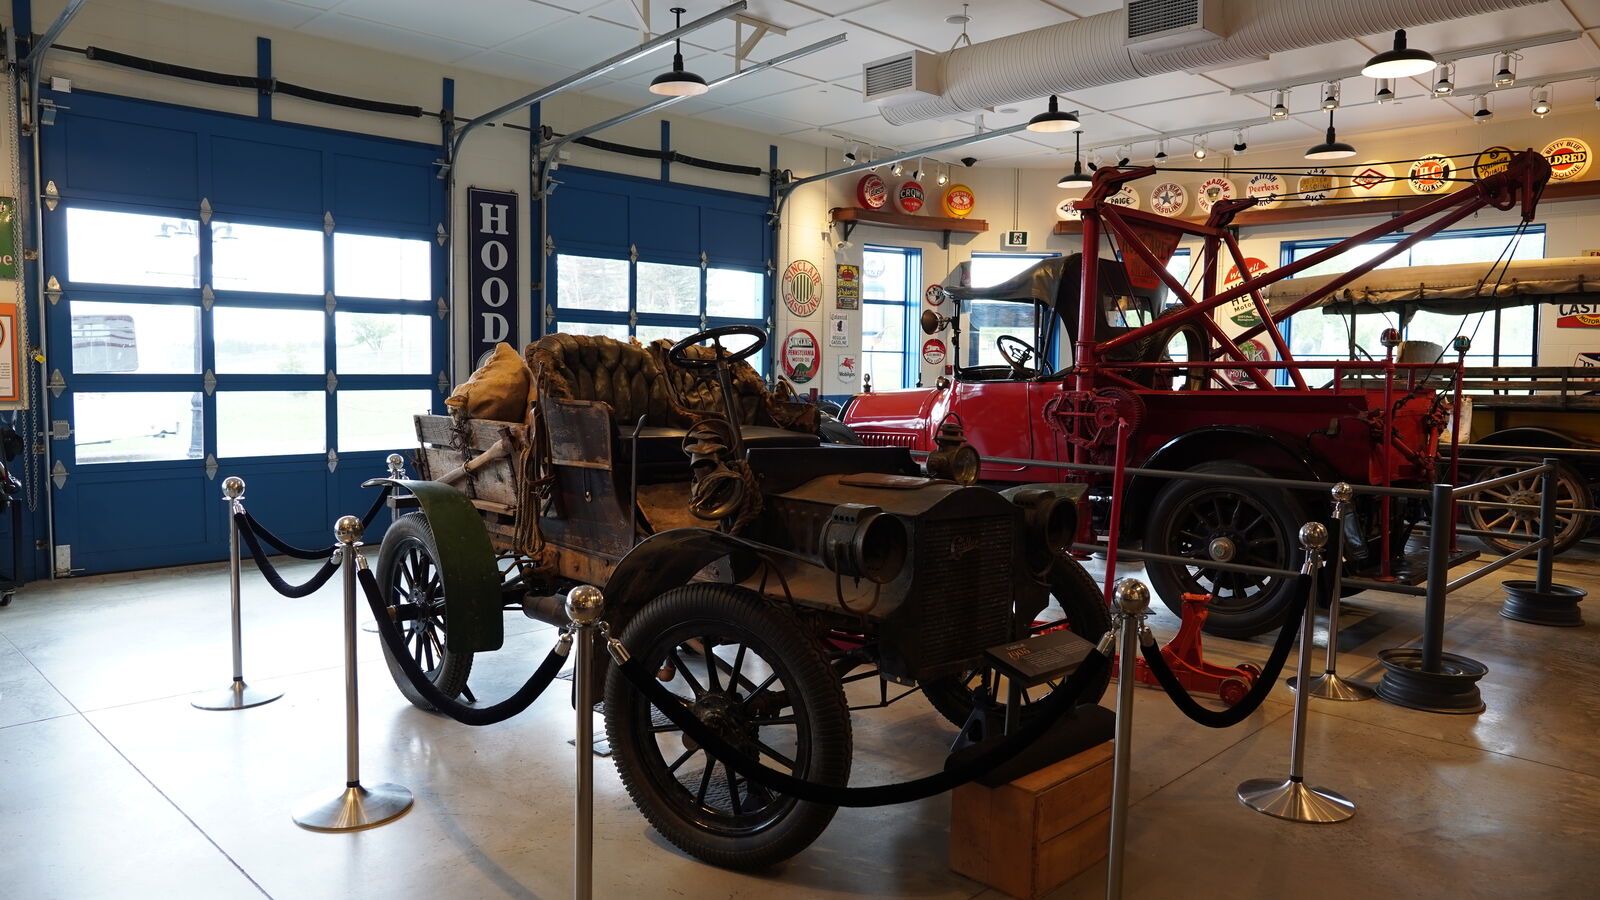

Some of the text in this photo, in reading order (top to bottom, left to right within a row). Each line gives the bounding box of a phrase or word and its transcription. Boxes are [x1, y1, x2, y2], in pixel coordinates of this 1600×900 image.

[1545, 141, 1582, 154] BETTY BLUE
[1545, 152, 1586, 165] LDRED
[1551, 164, 1581, 178] SOLINE
[1250, 173, 1278, 185] BRITISH
[1152, 183, 1184, 199] NORTH STAR
[1199, 178, 1231, 194] CANADIAN
[1248, 183, 1279, 194] Peerless
[900, 189, 923, 200] CROWN
[1110, 197, 1131, 205] PAIGE
[1154, 201, 1181, 214] GASOLINE
[479, 202, 510, 344] HOOD
[785, 261, 820, 286] SINCLAIR
[785, 293, 820, 315] GASOLINE
[1229, 370, 1249, 378] MOTO
